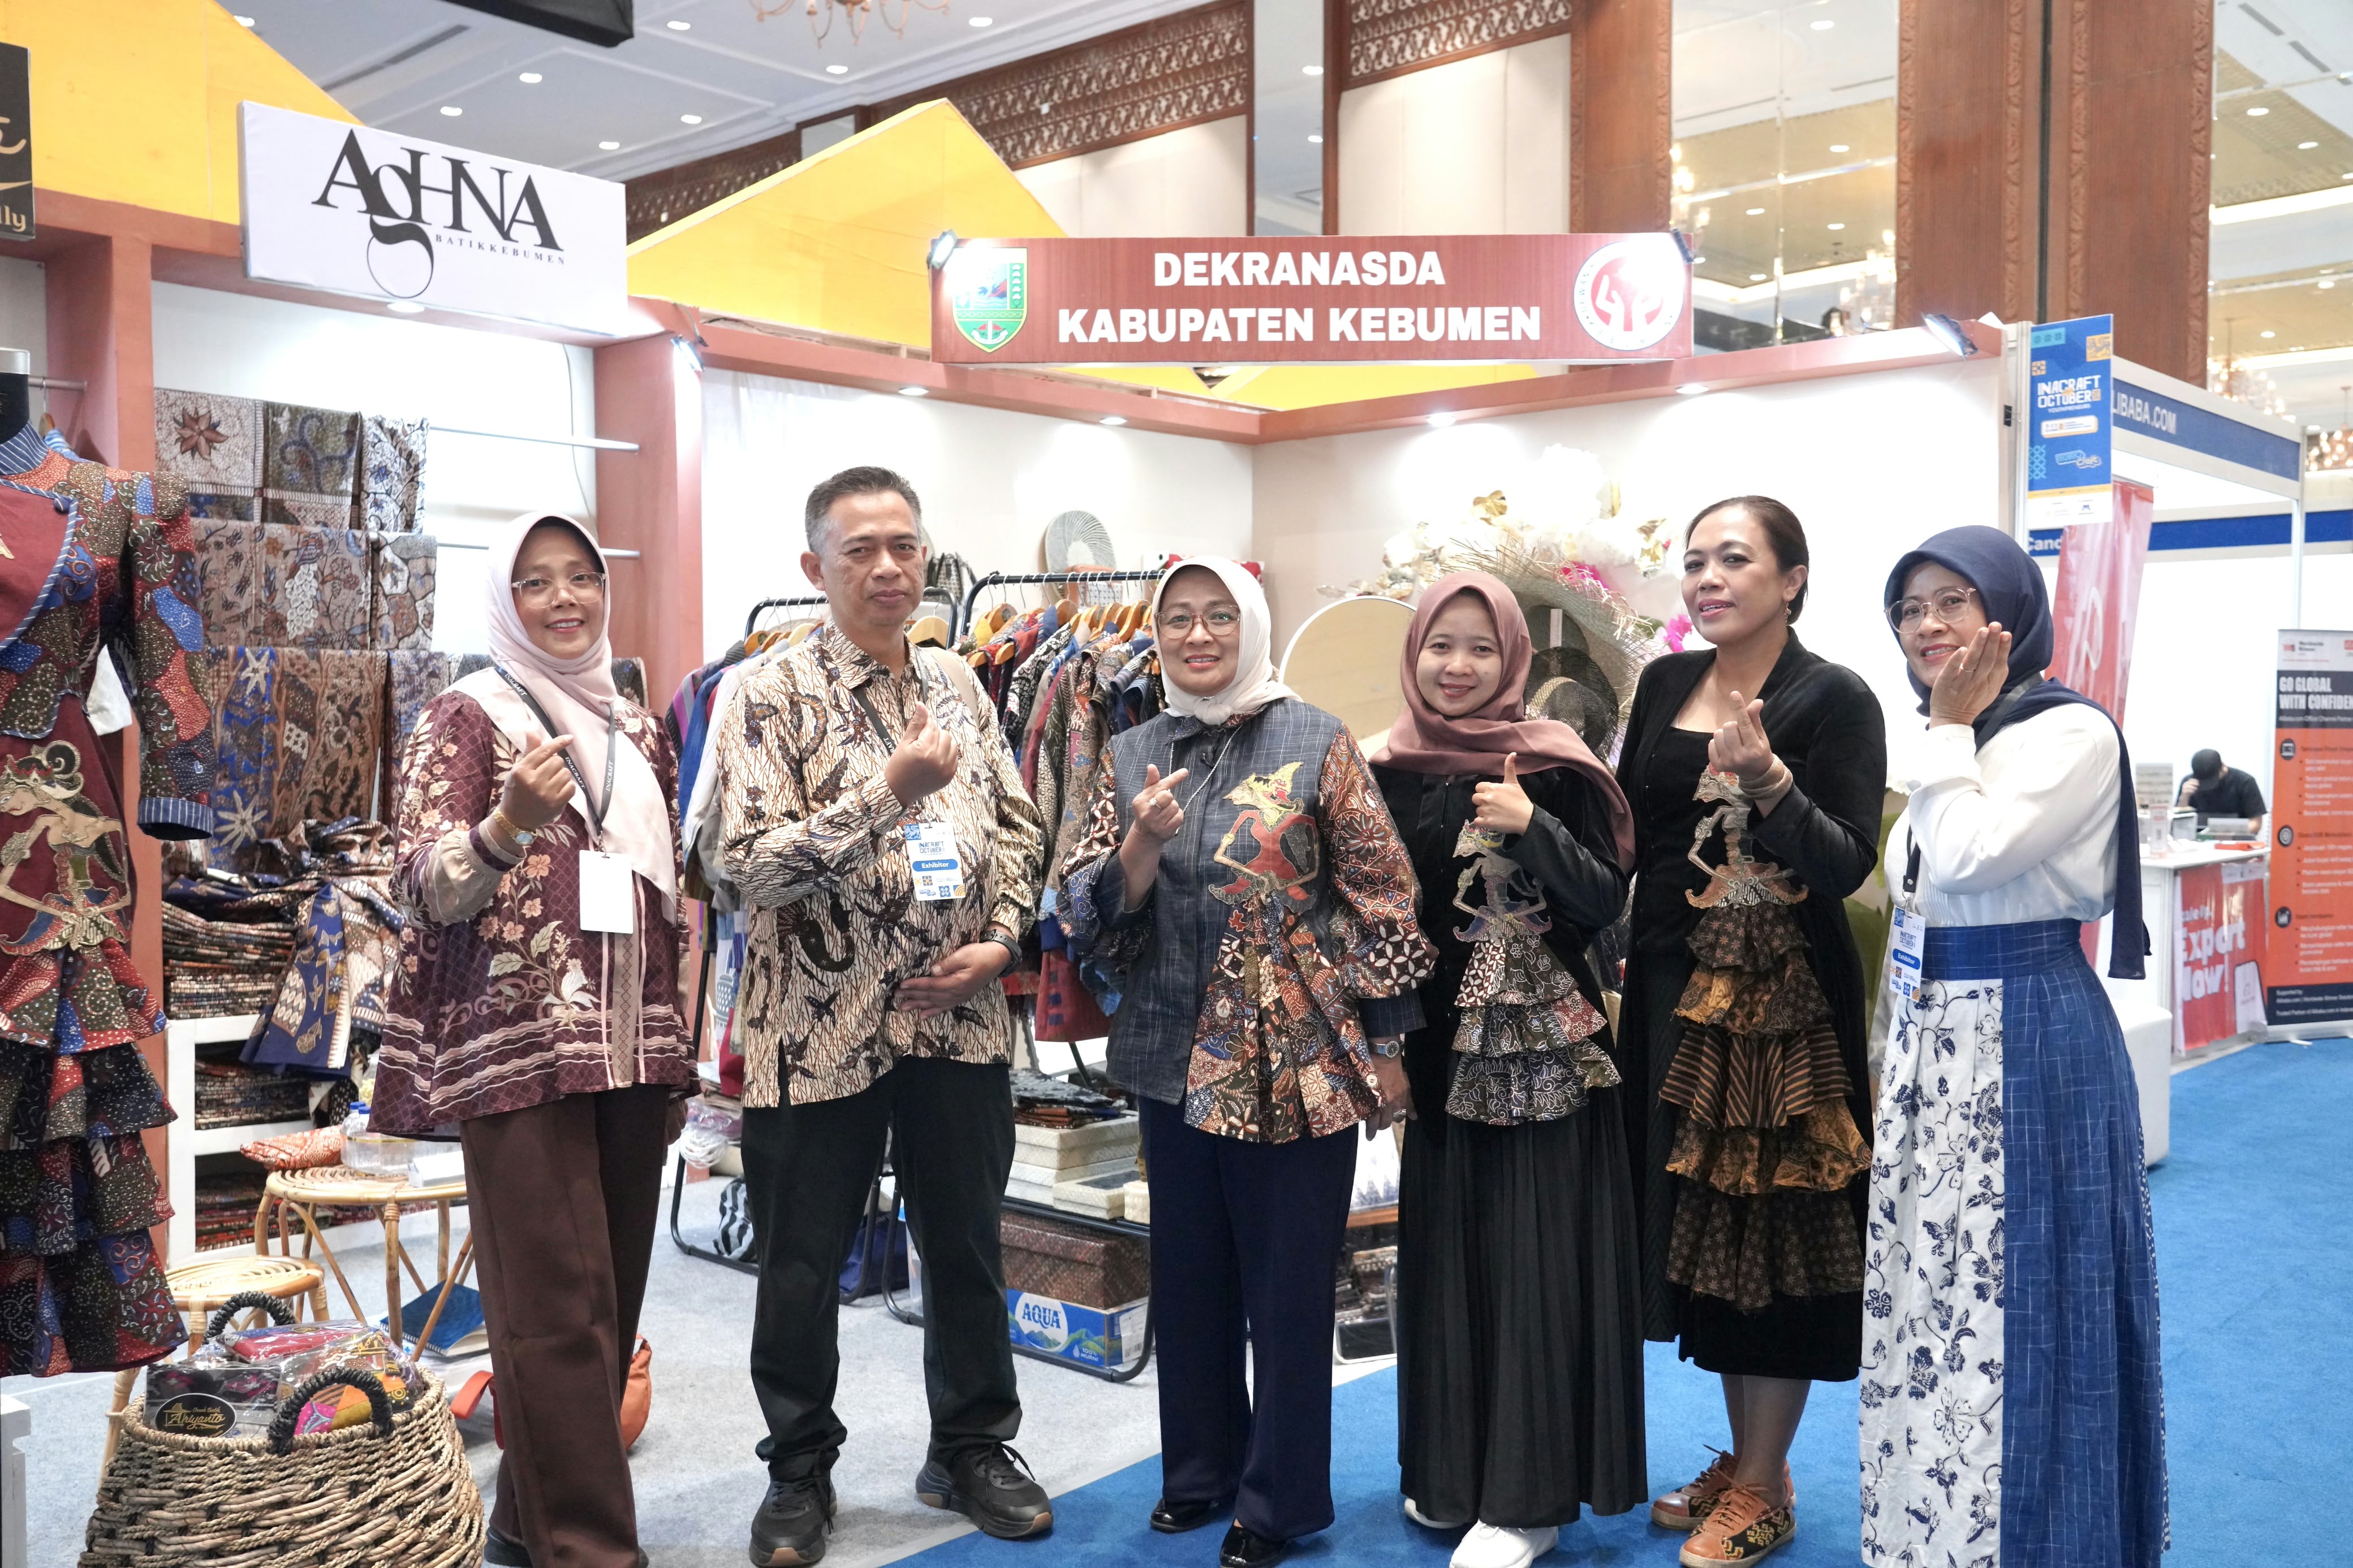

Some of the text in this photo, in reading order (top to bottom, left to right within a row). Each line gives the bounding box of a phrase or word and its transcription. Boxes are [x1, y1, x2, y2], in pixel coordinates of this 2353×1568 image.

[1154, 251, 1446, 286] DEKRANASDA
[1058, 306, 1541, 343] KABUPATEN KEBUMEN
[2037, 374, 2101, 396] INACRAFT
[2278, 676, 2332, 692] GO GLOBAL
[2279, 694, 2307, 710] WITH
[565, 757, 586, 789] INACRAFT
[1898, 952, 1916, 965] Exhibitor
[1022, 1302, 1061, 1329] AQUA
